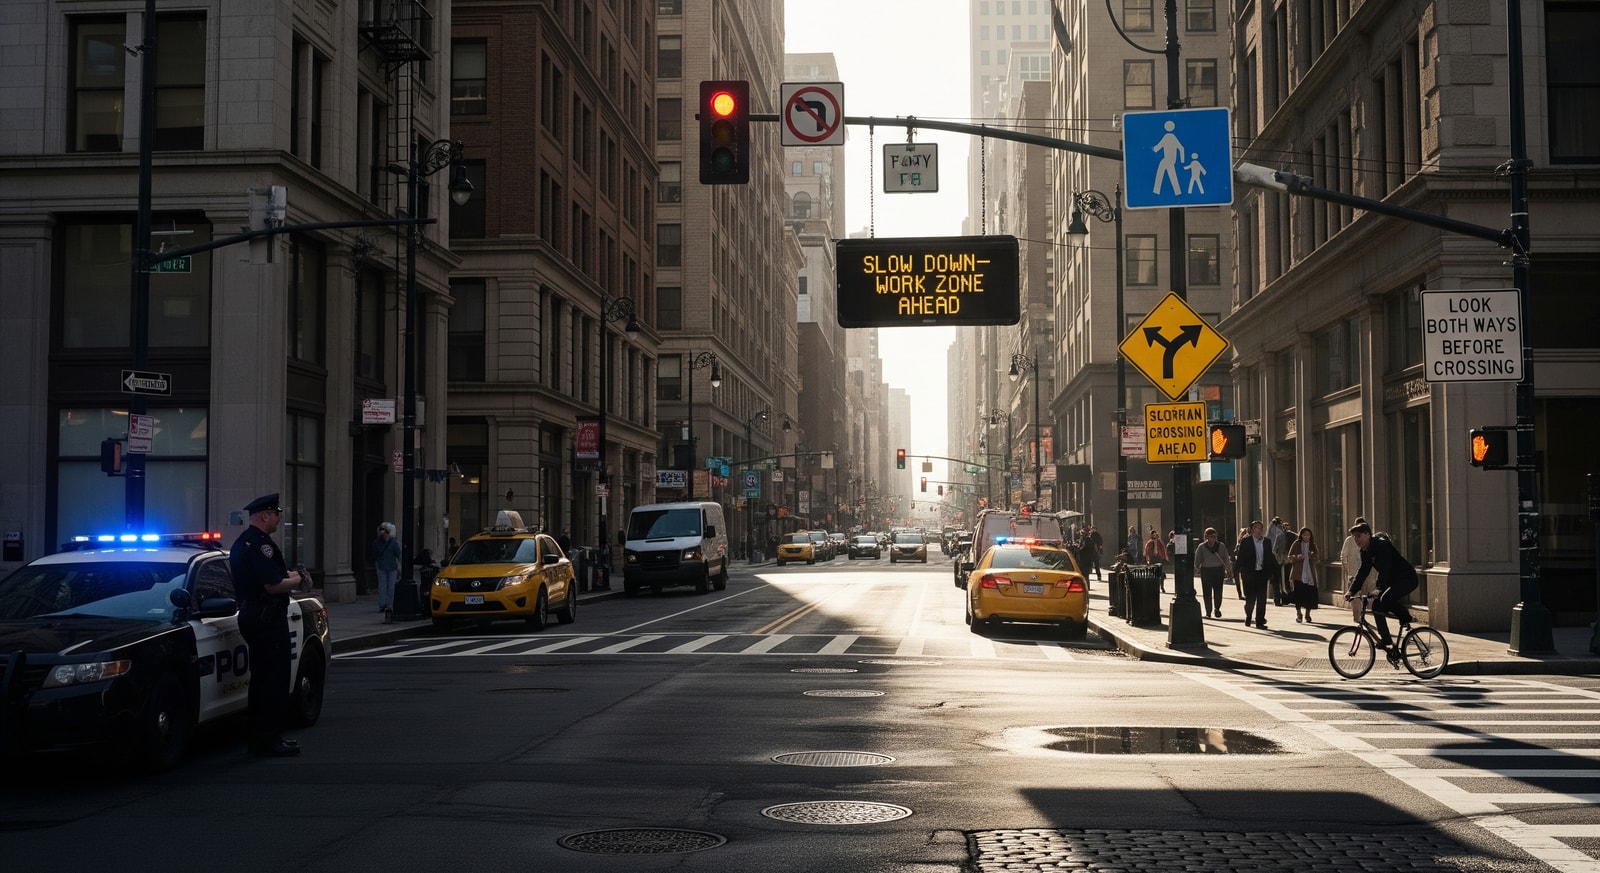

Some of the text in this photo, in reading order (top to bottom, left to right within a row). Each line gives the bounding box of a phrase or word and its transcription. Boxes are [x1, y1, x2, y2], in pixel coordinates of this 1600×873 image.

[863, 254, 913, 274] SLOW
[876, 273, 984, 295] WORK ZONE
[898, 295, 960, 315] AHEAD
[1449, 297, 1492, 313] LOOK
[1427, 316, 1516, 334] BOTH WAYS
[1442, 338, 1505, 355] BEFORE
[1434, 359, 1515, 376] CROSSING
[1150, 425, 1203, 439] CROSSING
[1158, 442, 1197, 455] AHEAD
